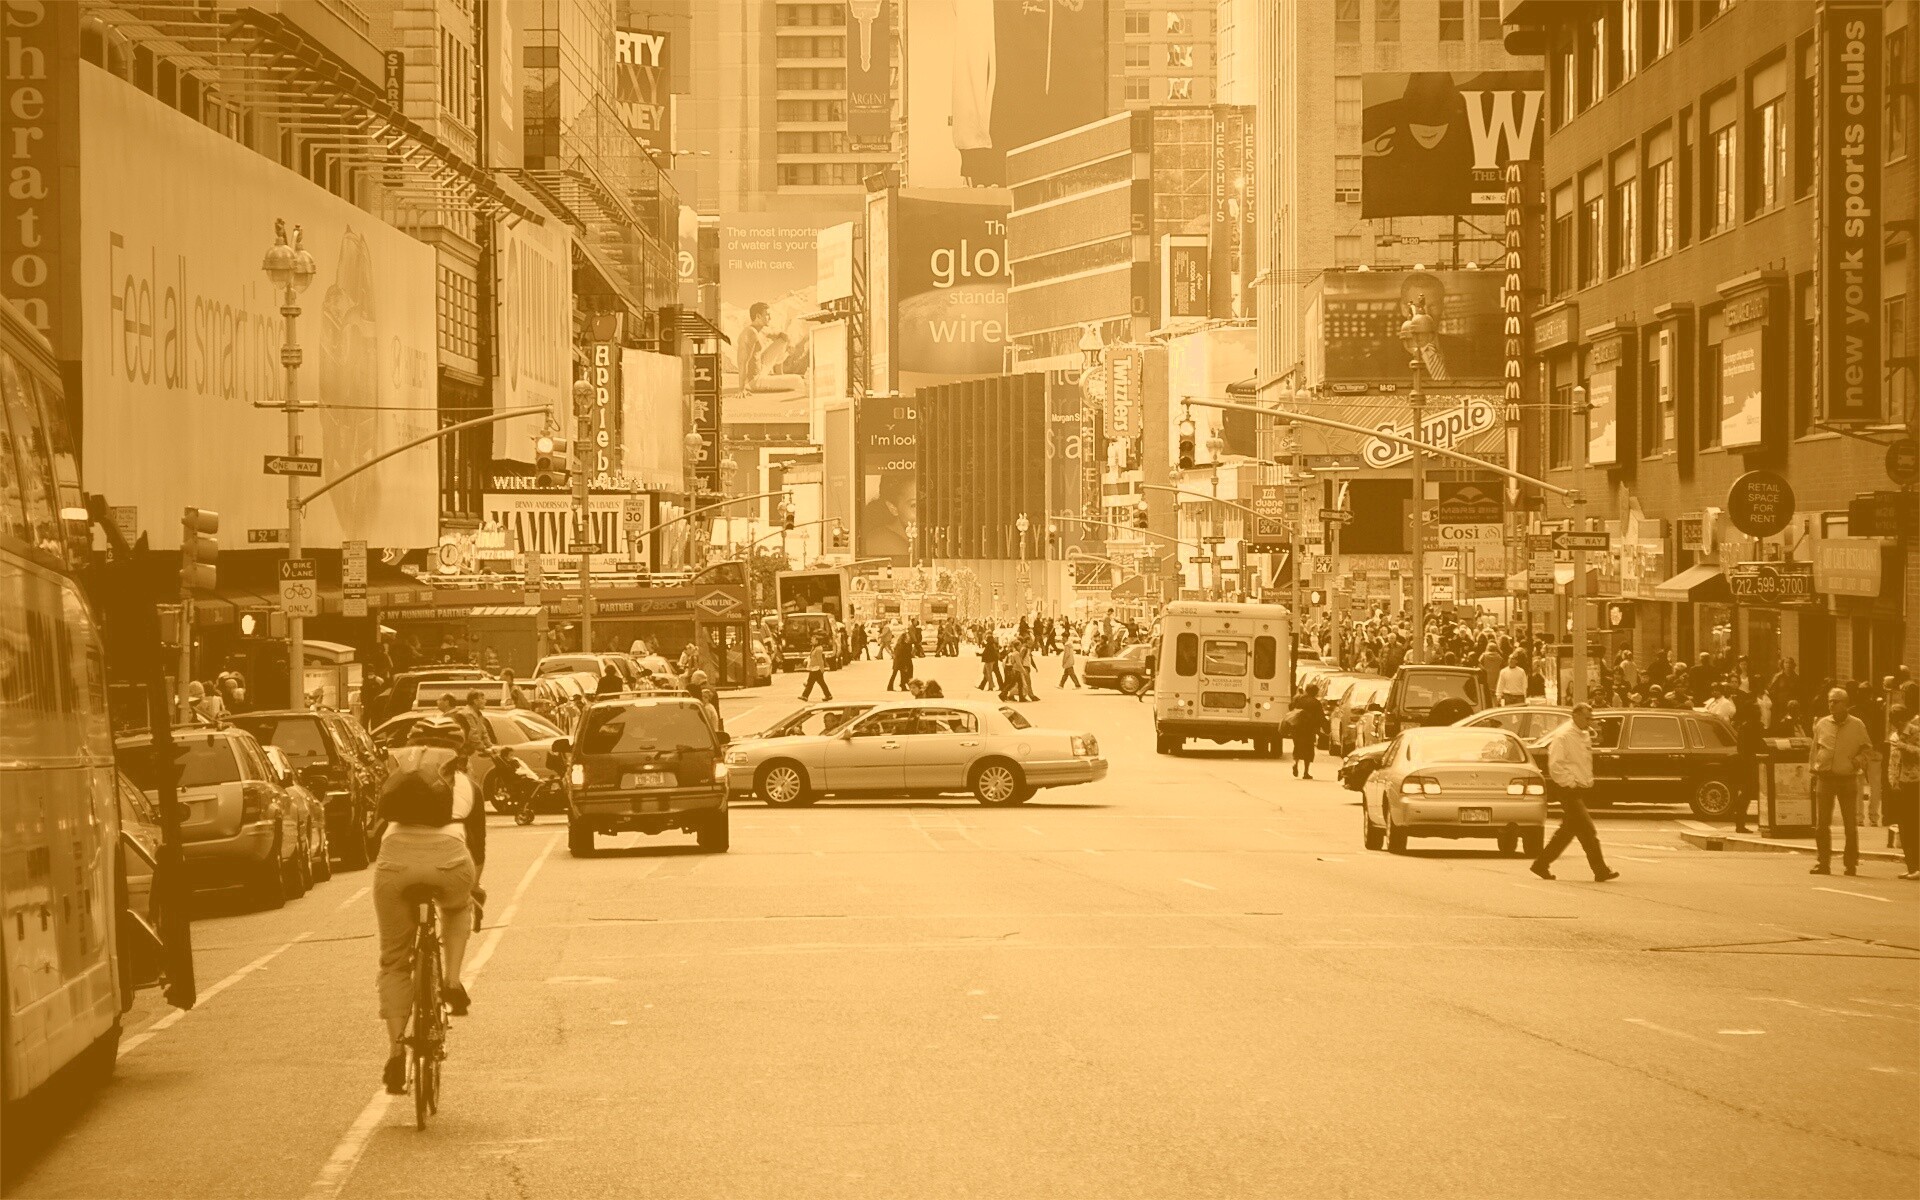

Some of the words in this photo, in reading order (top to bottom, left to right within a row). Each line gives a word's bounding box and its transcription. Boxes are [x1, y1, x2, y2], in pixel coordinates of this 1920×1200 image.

[1840, 20, 1866, 116] clubs
[6, 0, 51, 330] Sheraton
[1216, 122, 1225, 223] HERSHEYS
[1841, 123, 1871, 239] sports
[727, 227, 746, 237] The
[750, 227, 775, 238] most
[728, 240, 738, 250] of
[741, 240, 769, 250] water
[773, 240, 782, 250] is
[785, 241, 808, 253] your
[728, 260, 743, 270] Fill
[745, 260, 767, 270] with
[770, 261, 795, 270] care.
[1840, 248, 1870, 324] york
[110, 231, 156, 384] Feel
[164, 254, 188, 389] all
[195, 284, 248, 402] smart
[1846, 334, 1864, 408] new
[1113, 355, 1133, 432] Twizzlers
[871, 435, 890, 446] I'm
[272, 461, 290, 470] ONE
[296, 462, 314, 471] WAY
[1747, 482, 1780, 492] RETAIL
[1747, 494, 1780, 502] SPACE
[1753, 504, 1774, 513] FOR
[625, 512, 642, 522] 30
[1750, 514, 1777, 523] RENT
[258, 530, 268, 542] 52
[1441, 525, 1480, 540] Così
[1560, 537, 1577, 545] ONE
[1584, 538, 1603, 546] WAY
[1736, 576, 1803, 594] 212.599.3700
[288, 605, 309, 613] ONLY
[600, 602, 634, 612] PARTNER
[653, 600, 678, 610] asics
[703, 599, 719, 607] GRAY
[719, 599, 732, 607] LINE
[388, 610, 400, 619] MY
[402, 609, 436, 619] RUNNING
[437, 607, 472, 618] PARTNER
[1180, 607, 1198, 615] 3862
